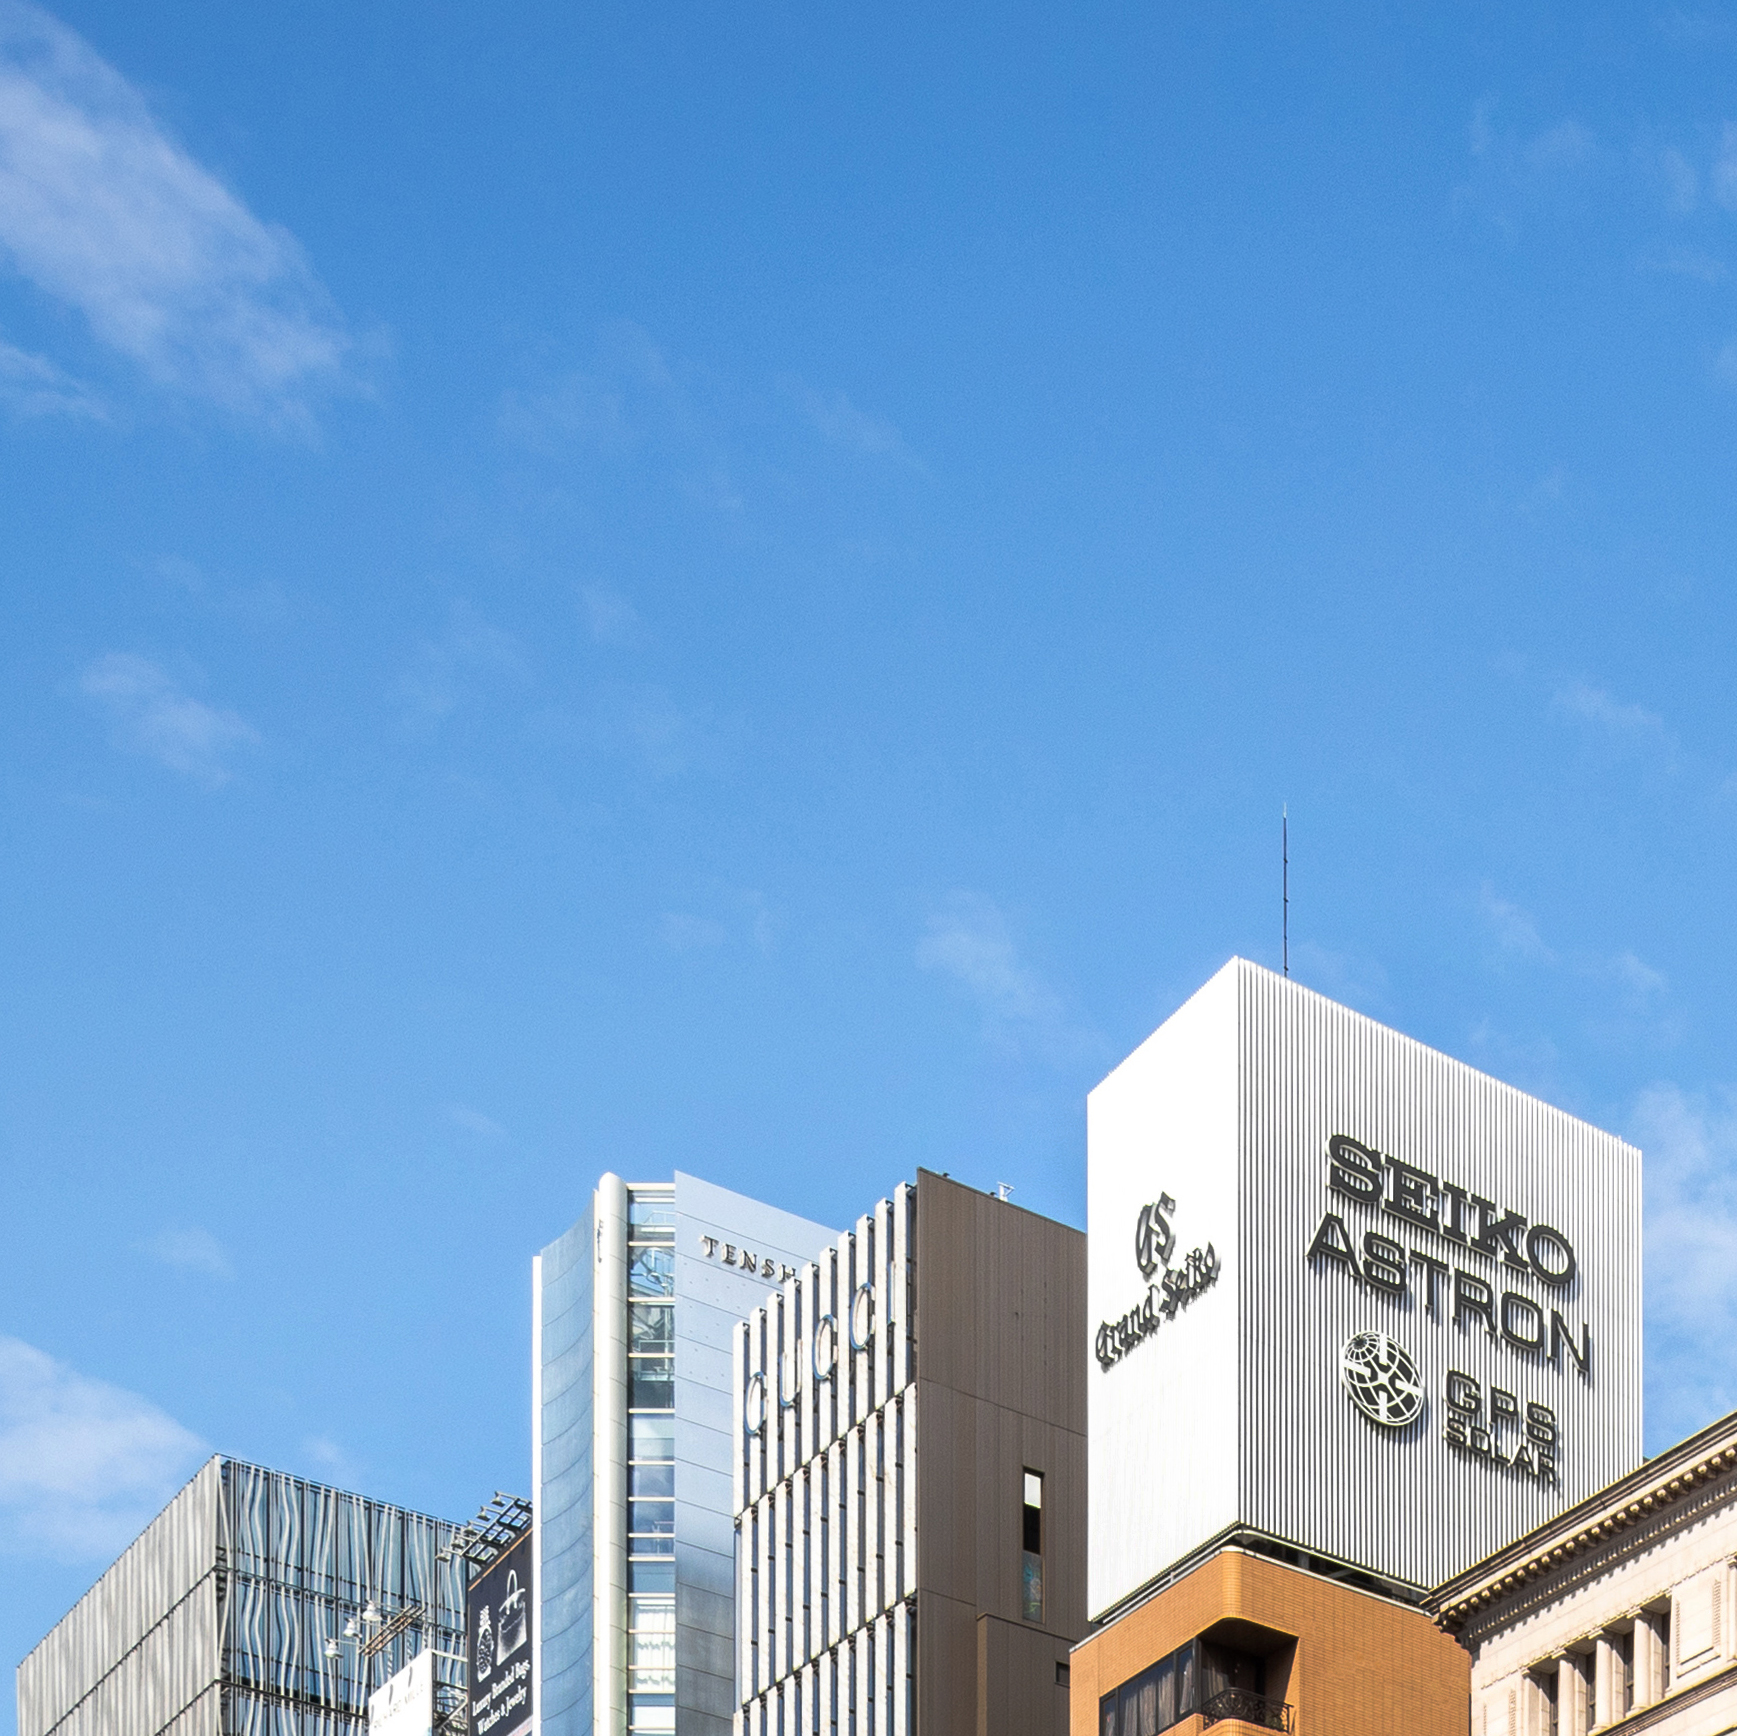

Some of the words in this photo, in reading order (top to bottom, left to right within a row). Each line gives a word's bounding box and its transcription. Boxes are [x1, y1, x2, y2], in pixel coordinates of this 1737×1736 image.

[1326, 1134, 1577, 1286] SEIKO
[1096, 1283, 1160, 1368] Grand
[1307, 1212, 1589, 1373] ASTRON
[1446, 1369, 1557, 1447] GPS
[1444, 1421, 1557, 1484] SOLAR
